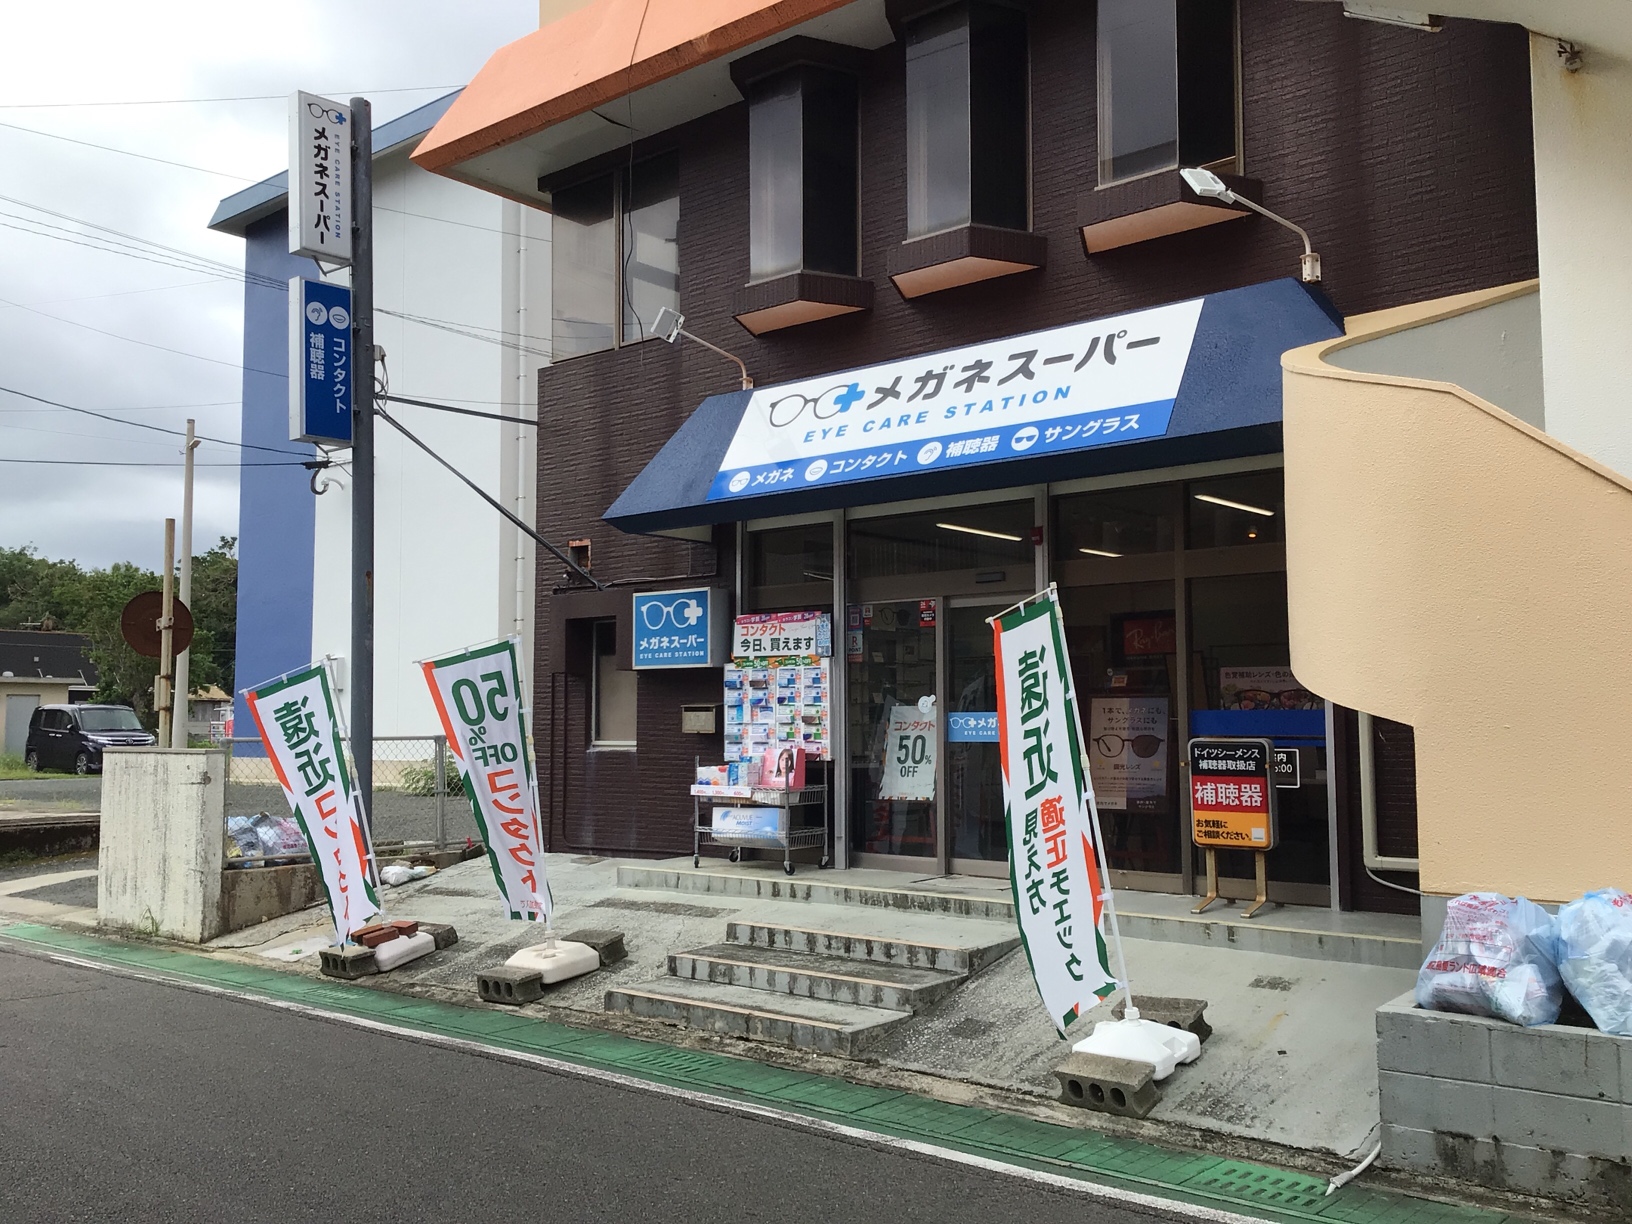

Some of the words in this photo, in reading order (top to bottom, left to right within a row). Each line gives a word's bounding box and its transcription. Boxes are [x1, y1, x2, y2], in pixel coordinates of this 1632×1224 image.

[333, 133, 341, 154] EYE
[333, 158, 342, 187] CARE
[313, 126, 331, 245] メガネスーパー
[333, 191, 342, 239] STATION
[309, 331, 326, 381] 補聴器
[333, 337, 347, 414] コンタクト
[866, 329, 1161, 411] メガネスーパー
[802, 424, 850, 444] EYE
[862, 413, 929, 434] CARE
[945, 385, 1073, 419] STATION
[751, 467, 795, 487] メガネ
[829, 449, 909, 475] コンタクト
[946, 434, 1000, 459] 補聴器
[1044, 414, 1141, 444] サングラス
[741, 623, 786, 637] コンタクト
[639, 635, 705, 650] メガネスーパー
[740, 637, 814, 652] 今日、買えます
[655, 651, 673, 659] CARE
[675, 650, 704, 658] STATION
[894, 720, 935, 732] コンタクト
[977, 717, 999, 729] メガ
[896, 734, 932, 765] 50%
[1194, 747, 1261, 758] ドイツシーメンス
[900, 766, 918, 778] OFF
[1198, 760, 1256, 771] 補聴器取扱店
[1194, 782, 1263, 807] 補聴器
[1196, 818, 1228, 829] お気軽に
